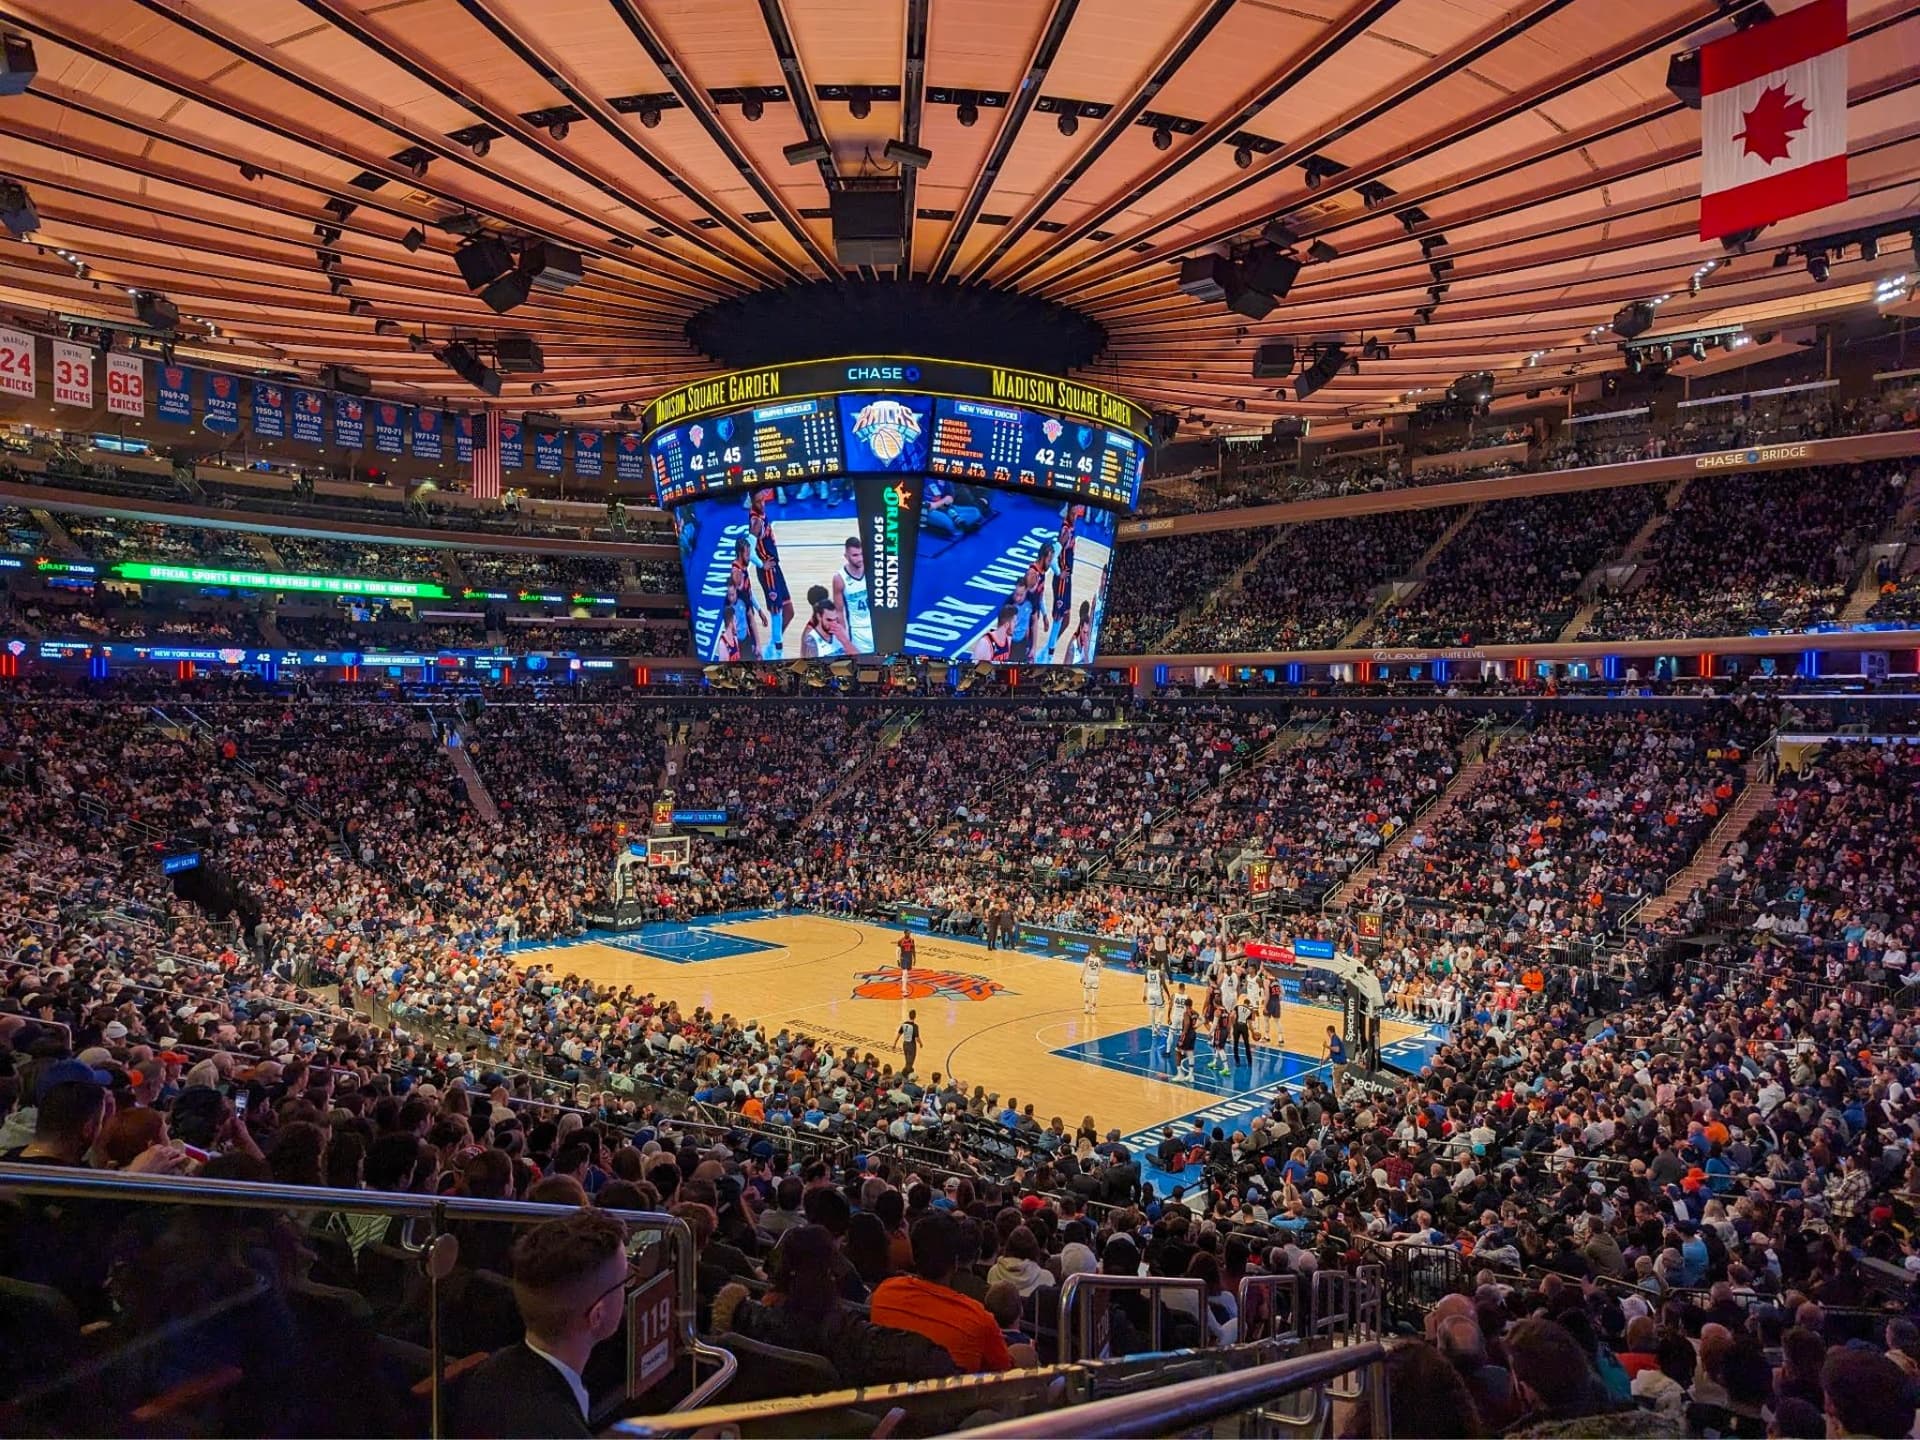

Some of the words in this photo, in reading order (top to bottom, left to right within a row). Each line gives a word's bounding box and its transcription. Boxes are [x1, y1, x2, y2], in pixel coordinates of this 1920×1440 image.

[0, 348, 31, 377] 24
[57, 361, 89, 388] 33
[848, 367, 903, 380] CHASE
[0, 376, 33, 392] KNICKS
[108, 371, 143, 397] 613
[56, 388, 90, 403] KNICKS
[160, 389, 189, 402] 1969-70
[656, 391, 686, 424] MADISON
[688, 381, 726, 412] SQUARE
[729, 371, 780, 402] GARDEN
[992, 369, 1054, 405] MADISON
[1058, 382, 1099, 416] SQUARE
[1101, 393, 1132, 427] GARDEN
[110, 397, 143, 412] KNICKS
[208, 398, 236, 410] 1972-73
[255, 407, 282, 417] 1950-51
[295, 413, 322, 424] 1951-52
[959, 404, 975, 413] NEW
[975, 407, 993, 416] YORK
[995, 411, 1018, 420] KNICKS
[336, 420, 363, 430] 1952-53
[376, 426, 402, 436] 1970-71
[942, 426, 971, 435] BARRETT
[415, 432, 440, 441] 1971-72
[759, 433, 781, 441] MORANT
[760, 439, 784, 448] JACKSON
[500, 442, 522, 451] 992-93
[941, 440, 966, 449] RANDLE
[723, 446, 741, 464] 45
[941, 447, 984, 459] HARTENSTEIN
[1035, 447, 1055, 466] 42
[1696, 454, 1744, 468] CHASE
[1762, 446, 1807, 460] BRIDGE
[690, 454, 704, 471] 42
[1060, 459, 1073, 468] 2:11
[1077, 456, 1093, 473] 45
[764, 471, 780, 480] 50.0
[787, 467, 804, 477] 43.6
[810, 466, 820, 474] 17
[827, 463, 839, 472] 39
[934, 463, 944, 472] 16
[951, 465, 963, 474] 39
[967, 468, 986, 477] 41.0
[994, 471, 1011, 480] 72.7
[1119, 524, 1140, 534] HASE
[884, 487, 898, 609] DRAFTKINGS
[38, 562, 95, 573] DRAFTKINGS
[701, 524, 750, 597] KNICKS
[874, 516, 884, 607] SPORTSBOOK
[965, 527, 1060, 595] KNICKS
[150, 567, 189, 578] OFFICIAL
[191, 571, 227, 582] SPORTS
[269, 576, 309, 587] PARTNER
[325, 580, 340, 590] THE
[342, 582, 360, 591] NEW
[365, 583, 386, 592] YORK
[389, 584, 417, 593] KNICKS
[464, 592, 507, 600] DRAFTKINGS
[520, 594, 562, 602] DRAFTKINGS
[257, 653, 271, 662] 42
[281, 657, 301, 665] 2:11
[314, 655, 327, 663] 45
[363, 656, 391, 664] MEMPHIS
[1463, 650, 1486, 658] LEVEL
[1253, 875, 1266, 891] 24
[1089, 960, 1098, 968] 24
[1345, 998, 1355, 1042] Spectrum
[1195, 1098, 1267, 1123] YORK
[1119, 1120, 1196, 1154] KNICK
[641, 1297, 670, 1346] 119
